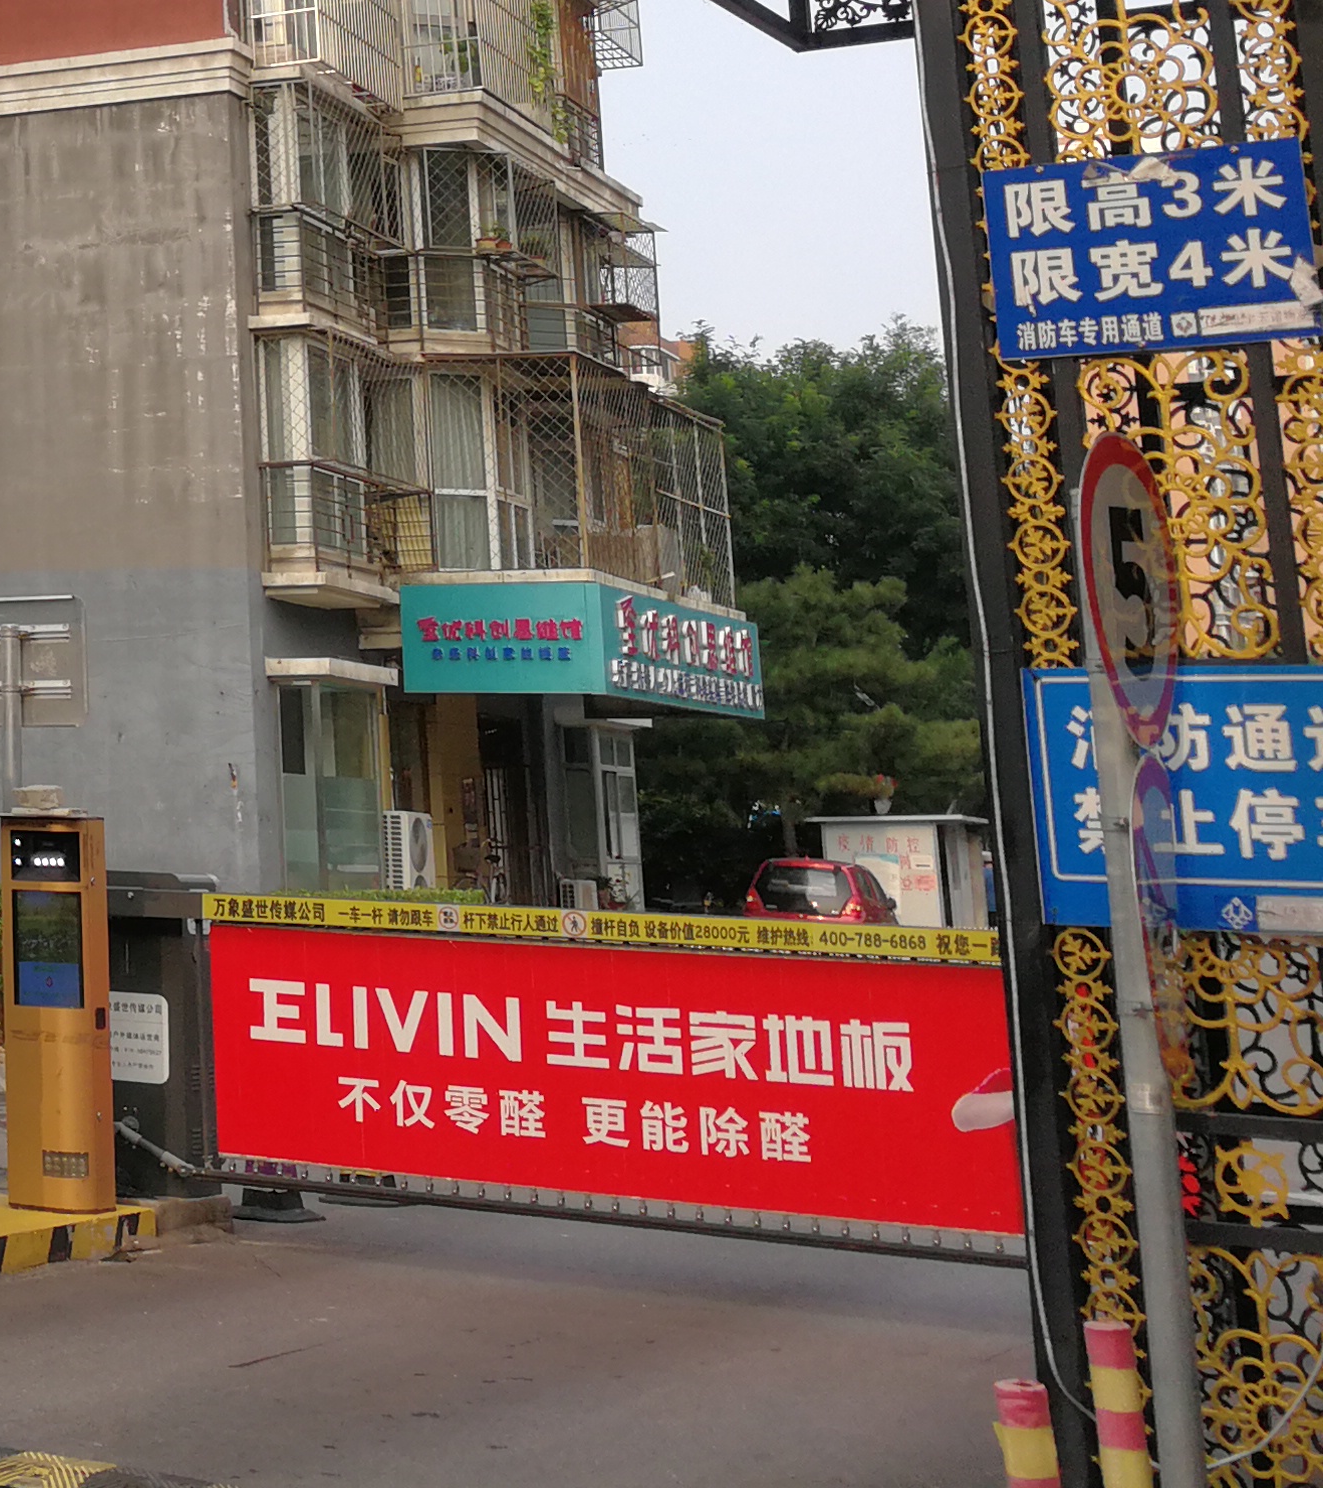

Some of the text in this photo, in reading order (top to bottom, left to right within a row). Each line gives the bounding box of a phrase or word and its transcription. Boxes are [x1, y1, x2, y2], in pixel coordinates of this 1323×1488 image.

[1005, 157, 1286, 240] 限高3米
[1011, 228, 1292, 308] 限宽4米
[1017, 312, 1163, 351] 消防车专用通道
[213, 898, 325, 923] 万象盛世传媒公司
[339, 906, 383, 924] 一车一杆
[388, 907, 433, 927] 请勿跟车
[463, 911, 558, 933] 杆下禁止行人通过
[591, 917, 640, 939] 撞杆自负
[644, 920, 750, 944] 设备价值28000元
[820, 930, 927, 951] 400-788-6868
[109, 1002, 163, 1015] 盛世传媒公司
[546, 1000, 914, 1093] 生活家地板
[338, 1077, 813, 1164] 不仅零醛 更能除醛
